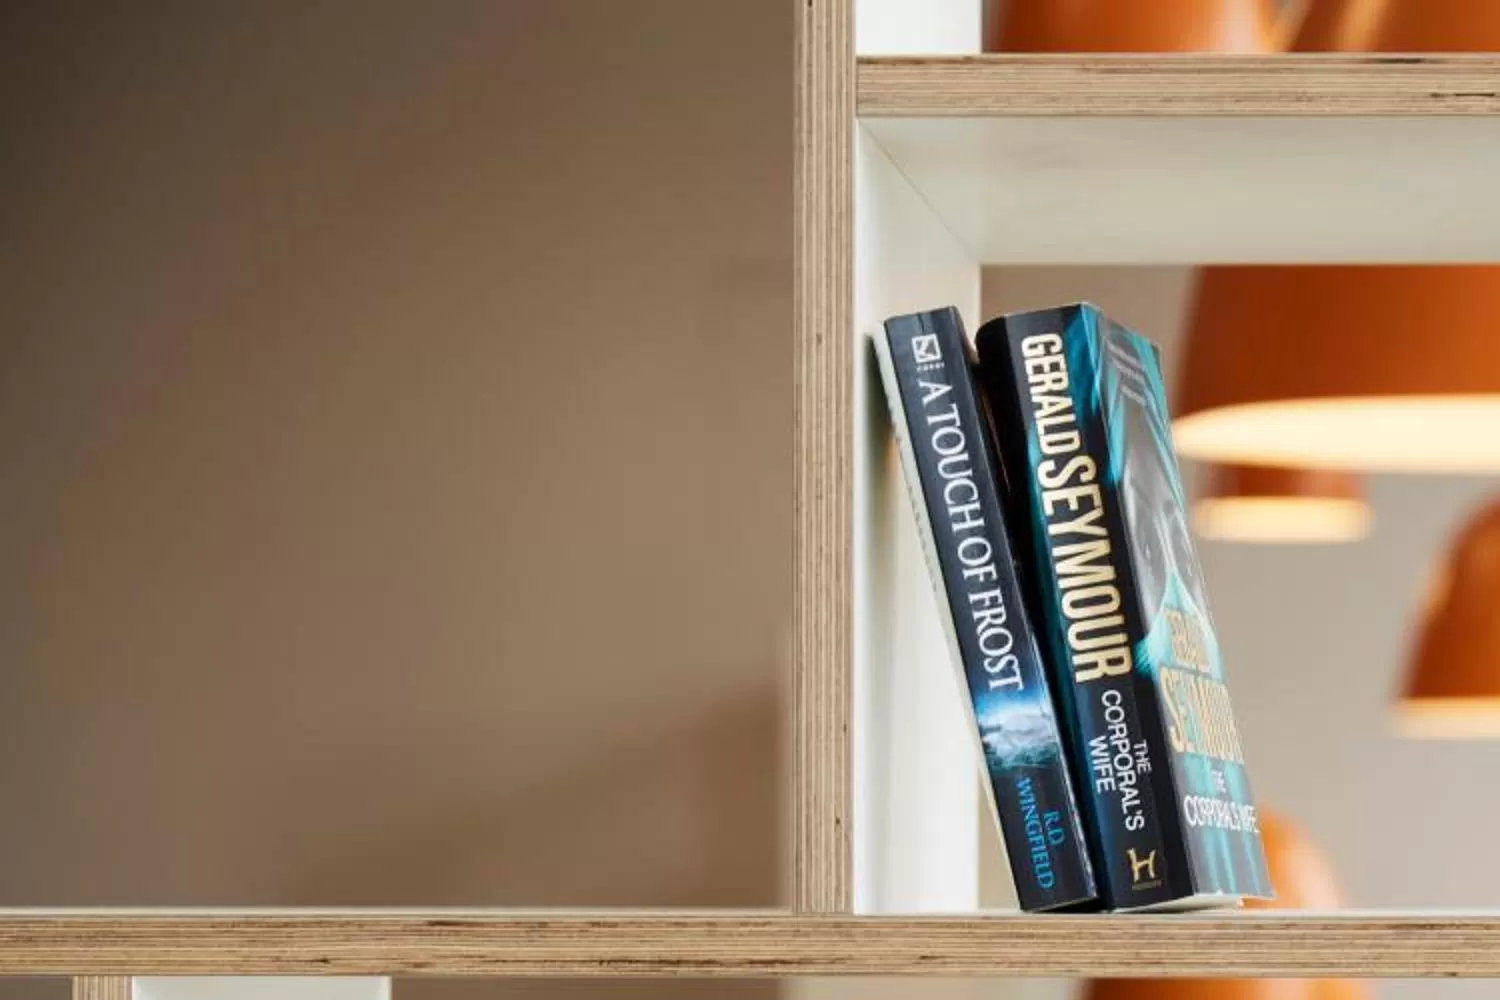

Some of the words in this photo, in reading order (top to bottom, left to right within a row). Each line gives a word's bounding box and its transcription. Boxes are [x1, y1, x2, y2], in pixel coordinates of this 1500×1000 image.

[918, 379, 952, 406] A
[1022, 333, 1080, 456] GERALD
[926, 403, 985, 533] TOUCH
[957, 536, 998, 581] OF
[1037, 454, 1132, 683] SEYMOUR
[968, 588, 1024, 691] FROST
[1088, 735, 1116, 794] WIFE
[1101, 689, 1145, 831] CORPORAL'S
[1134, 739, 1151, 775] THE
[1016, 776, 1055, 889] WINGFIELD
